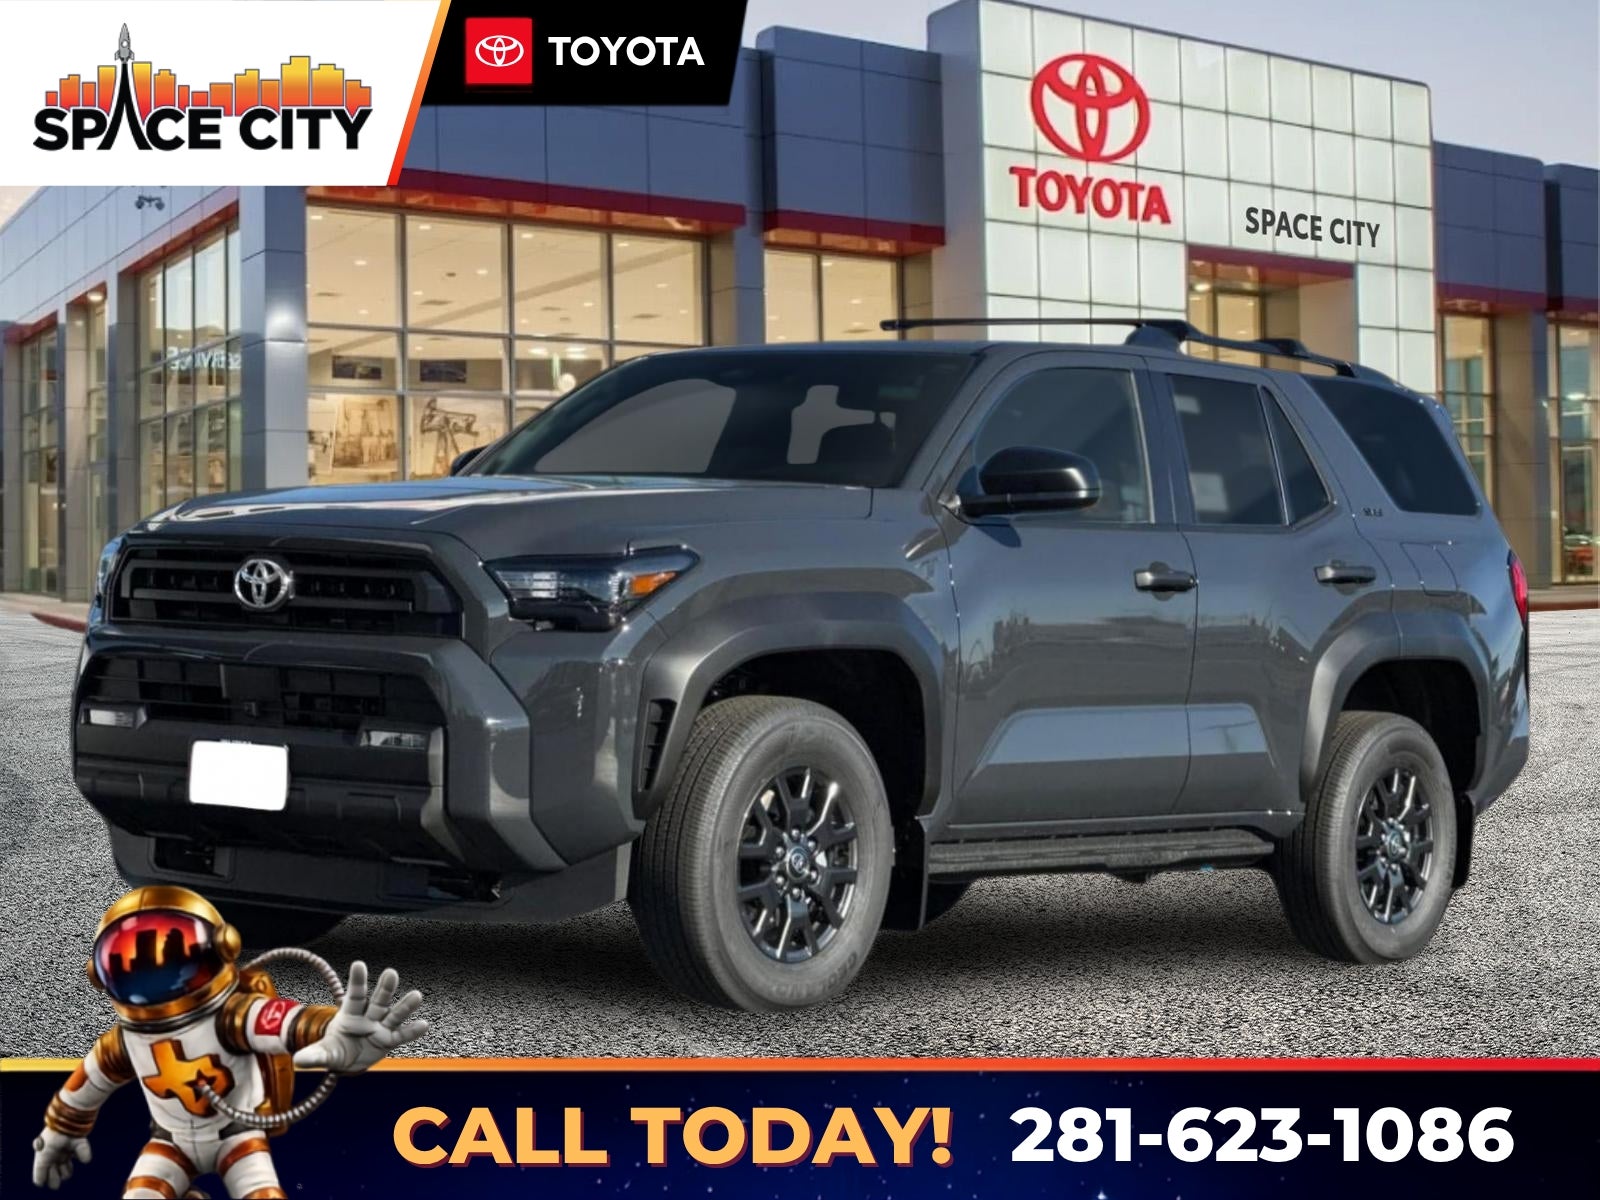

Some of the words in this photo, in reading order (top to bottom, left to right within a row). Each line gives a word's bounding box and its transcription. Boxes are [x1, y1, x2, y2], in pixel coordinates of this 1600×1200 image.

[1008, 165, 1172, 225] TOYOTA
[1245, 206, 1323, 242] SPACE
[1329, 218, 1381, 248] CITY
